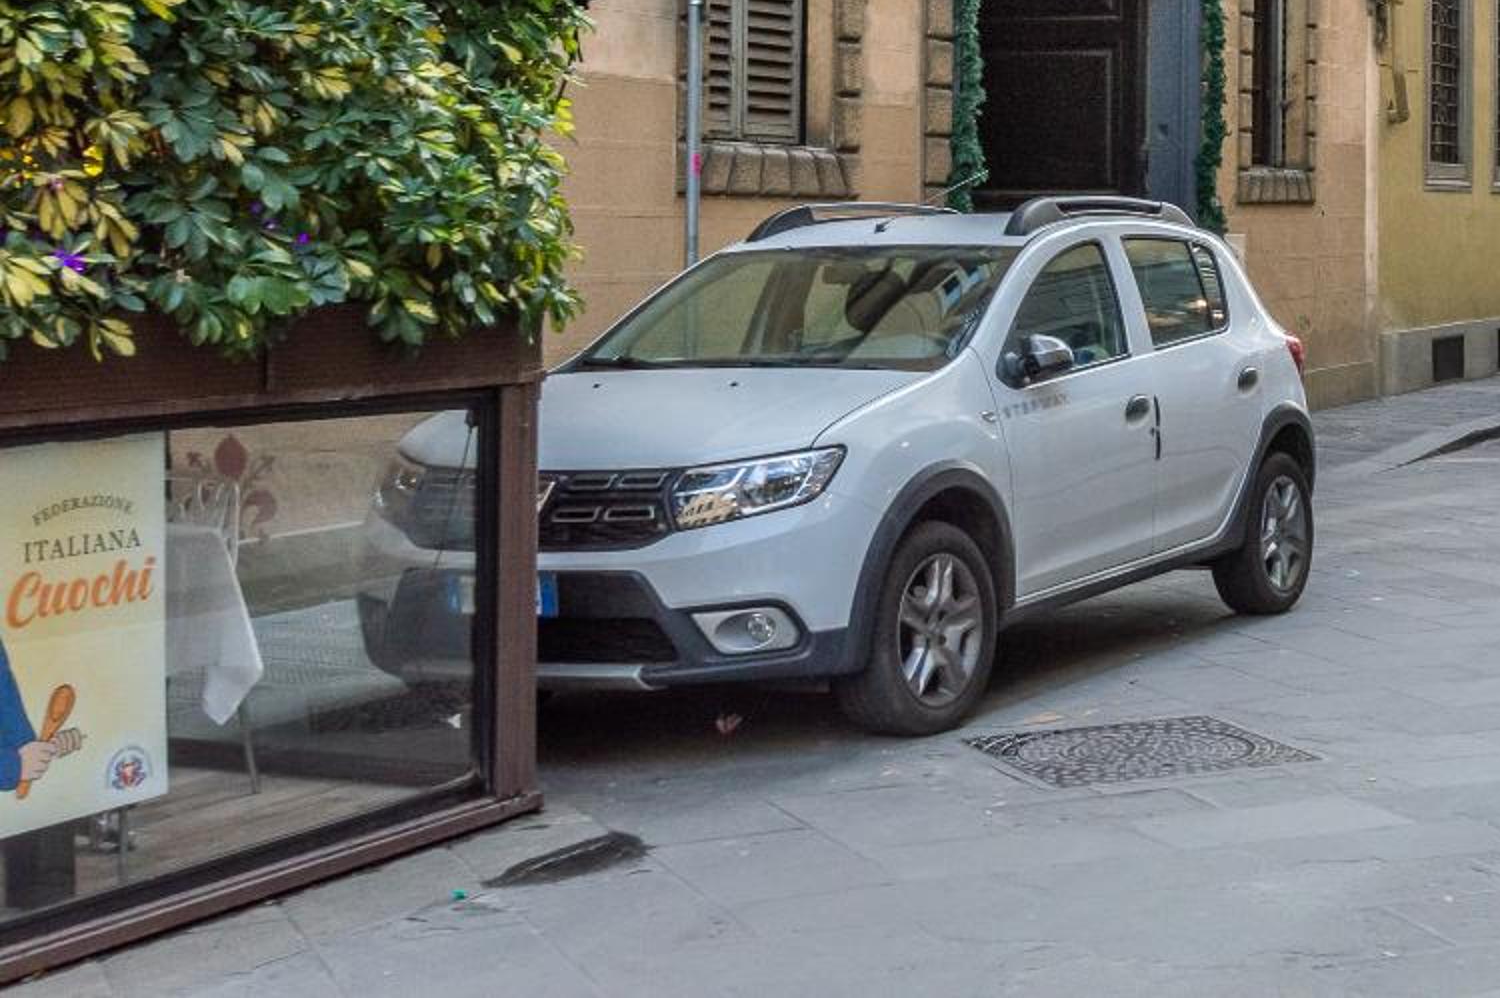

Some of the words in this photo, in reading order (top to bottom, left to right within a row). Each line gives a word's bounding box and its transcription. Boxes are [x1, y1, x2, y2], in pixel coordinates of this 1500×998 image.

[31, 495, 137, 527] FEDERAZIONE
[22, 527, 142, 564] ITALIANA
[6, 555, 157, 629] Cuochi
